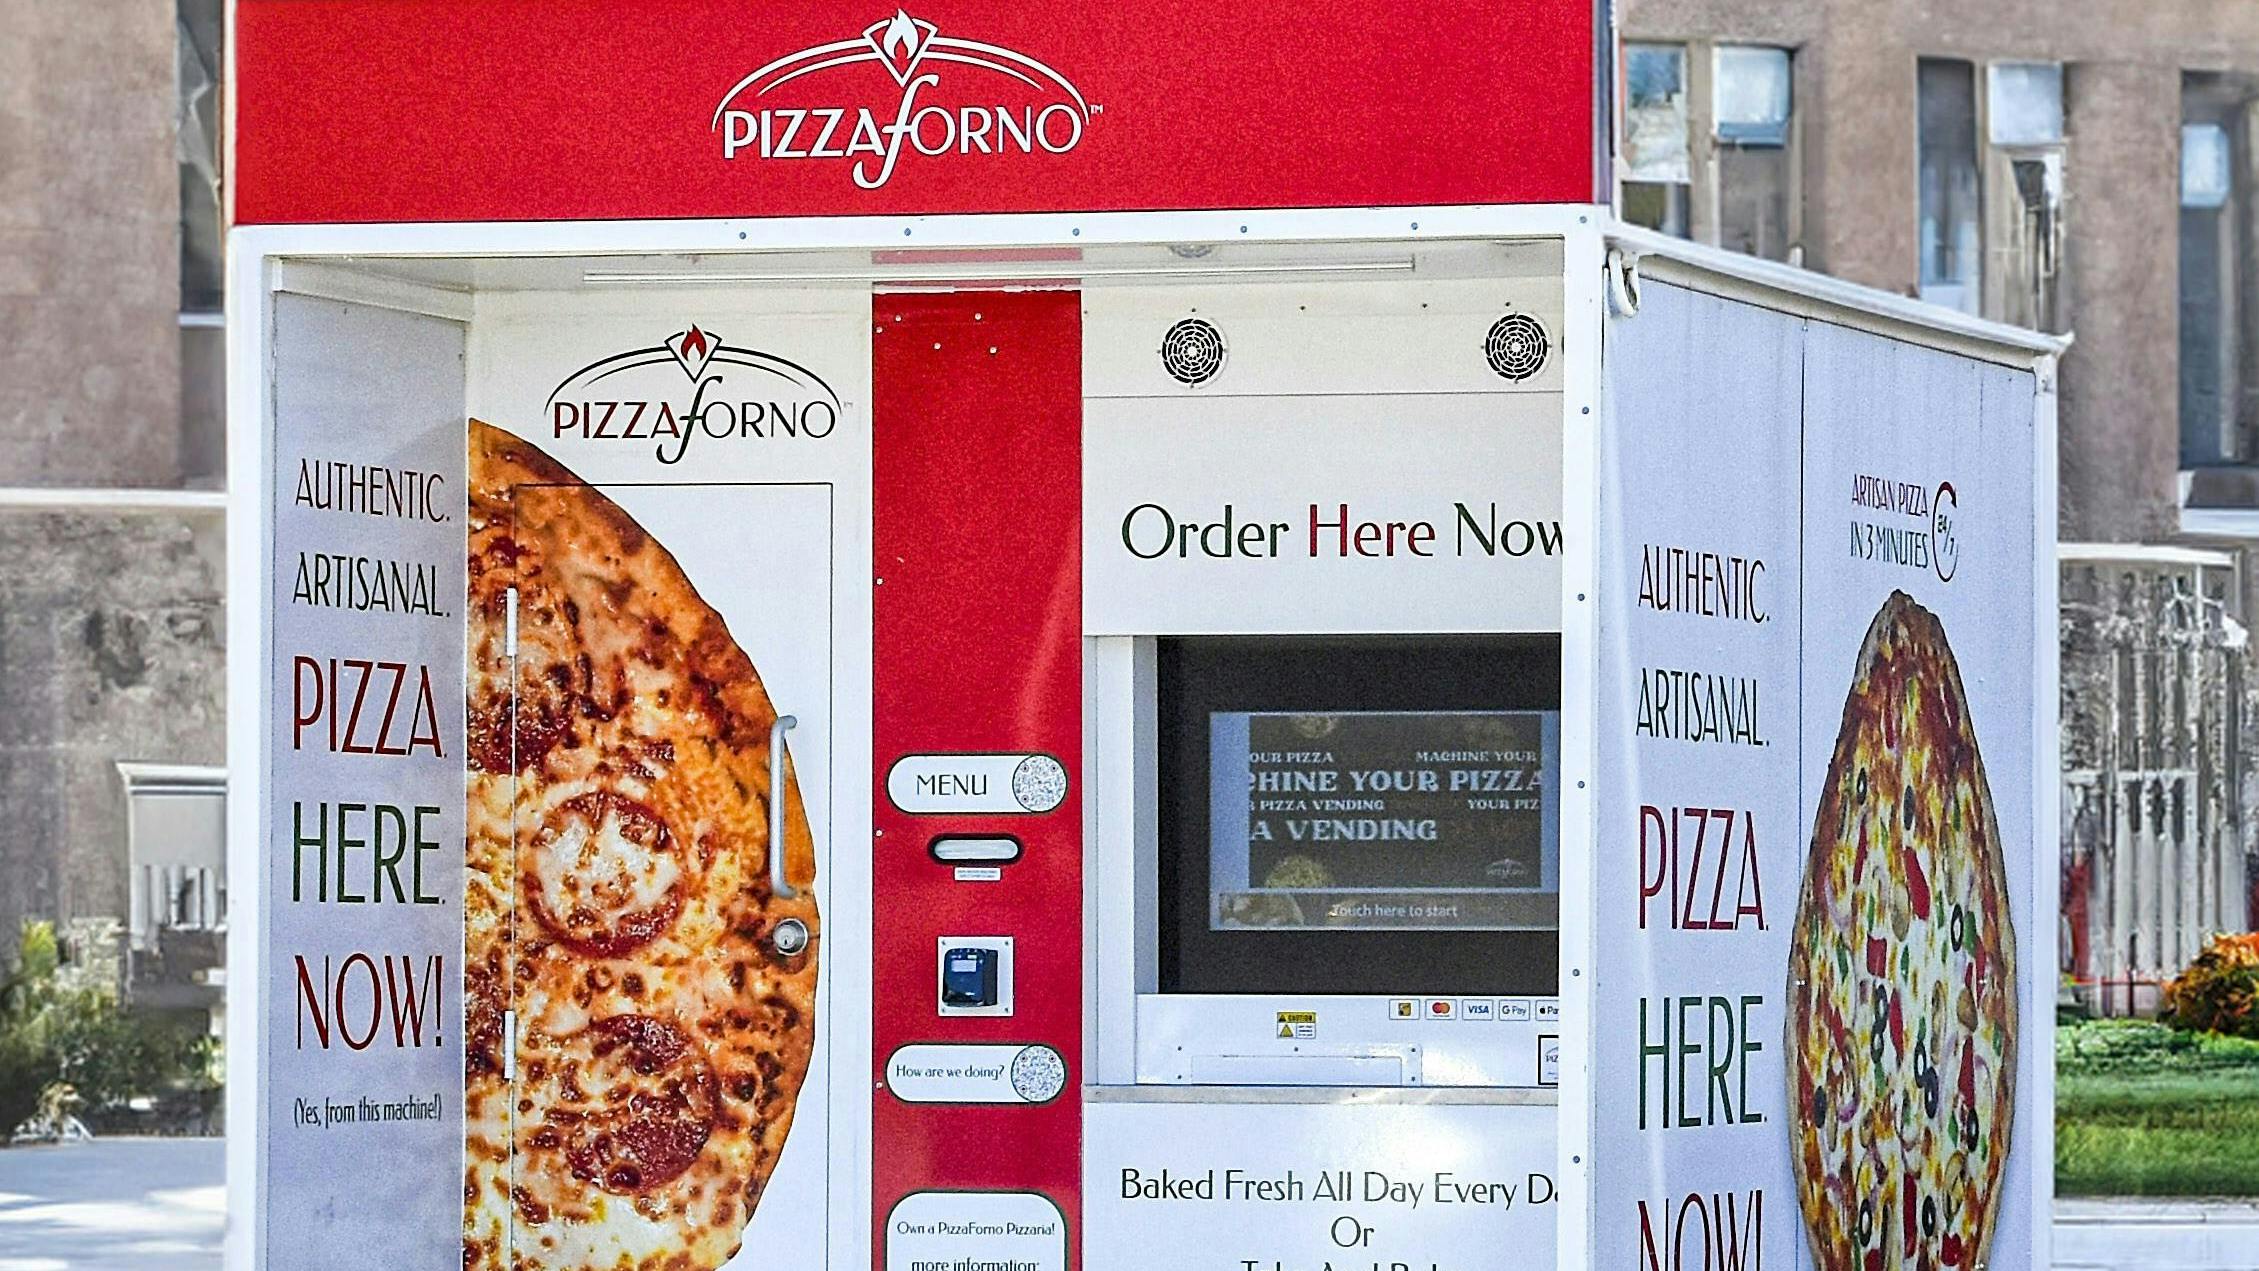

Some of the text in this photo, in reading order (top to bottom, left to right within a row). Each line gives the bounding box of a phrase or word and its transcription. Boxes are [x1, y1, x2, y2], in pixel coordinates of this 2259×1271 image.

[296, 458, 451, 523] AUTHENTIC.
[1852, 474, 1929, 518] ARTISAN PIZZA
[1121, 503, 1290, 560] Order
[1309, 503, 1436, 557] Here
[1850, 520, 1929, 569] IN 3 MINUTES
[293, 552, 451, 618] ARTISANAL.
[1638, 544, 1770, 624] AUTHENTIC.
[293, 656, 448, 759] PIZZA.
[1636, 667, 1770, 747] ARTISANAL.
[1286, 751, 1334, 763] PIZZA
[1494, 751, 1537, 762] YOUR
[916, 774, 987, 796] MENU
[1350, 770, 1439, 792] YOUR
[1260, 800, 1307, 811] PIZZA
[1311, 800, 1385, 811] VENDING
[1468, 799, 1510, 810] YOUR
[1285, 819, 1437, 841] VENDING
[292, 801, 446, 905] HERE.
[1639, 805, 1769, 931] PIZZA.
[1332, 904, 1458, 918] Touch here to start
[294, 953, 443, 1051] NOW!
[1468, 1005, 1489, 1014] VISA
[896, 1064, 1005, 1080] How are we doing?
[1639, 995, 1767, 1131] HERE.
[294, 1093, 441, 1129] (Yes, from this machine!)
[1121, 1168, 1558, 1210] Baked Fresh All Day Every D
[897, 1221, 924, 1234] Own
[928, 1225, 935, 1234] a
[938, 1221, 1003, 1235] PizzaForno
[1331, 1216, 1375, 1247] Or
